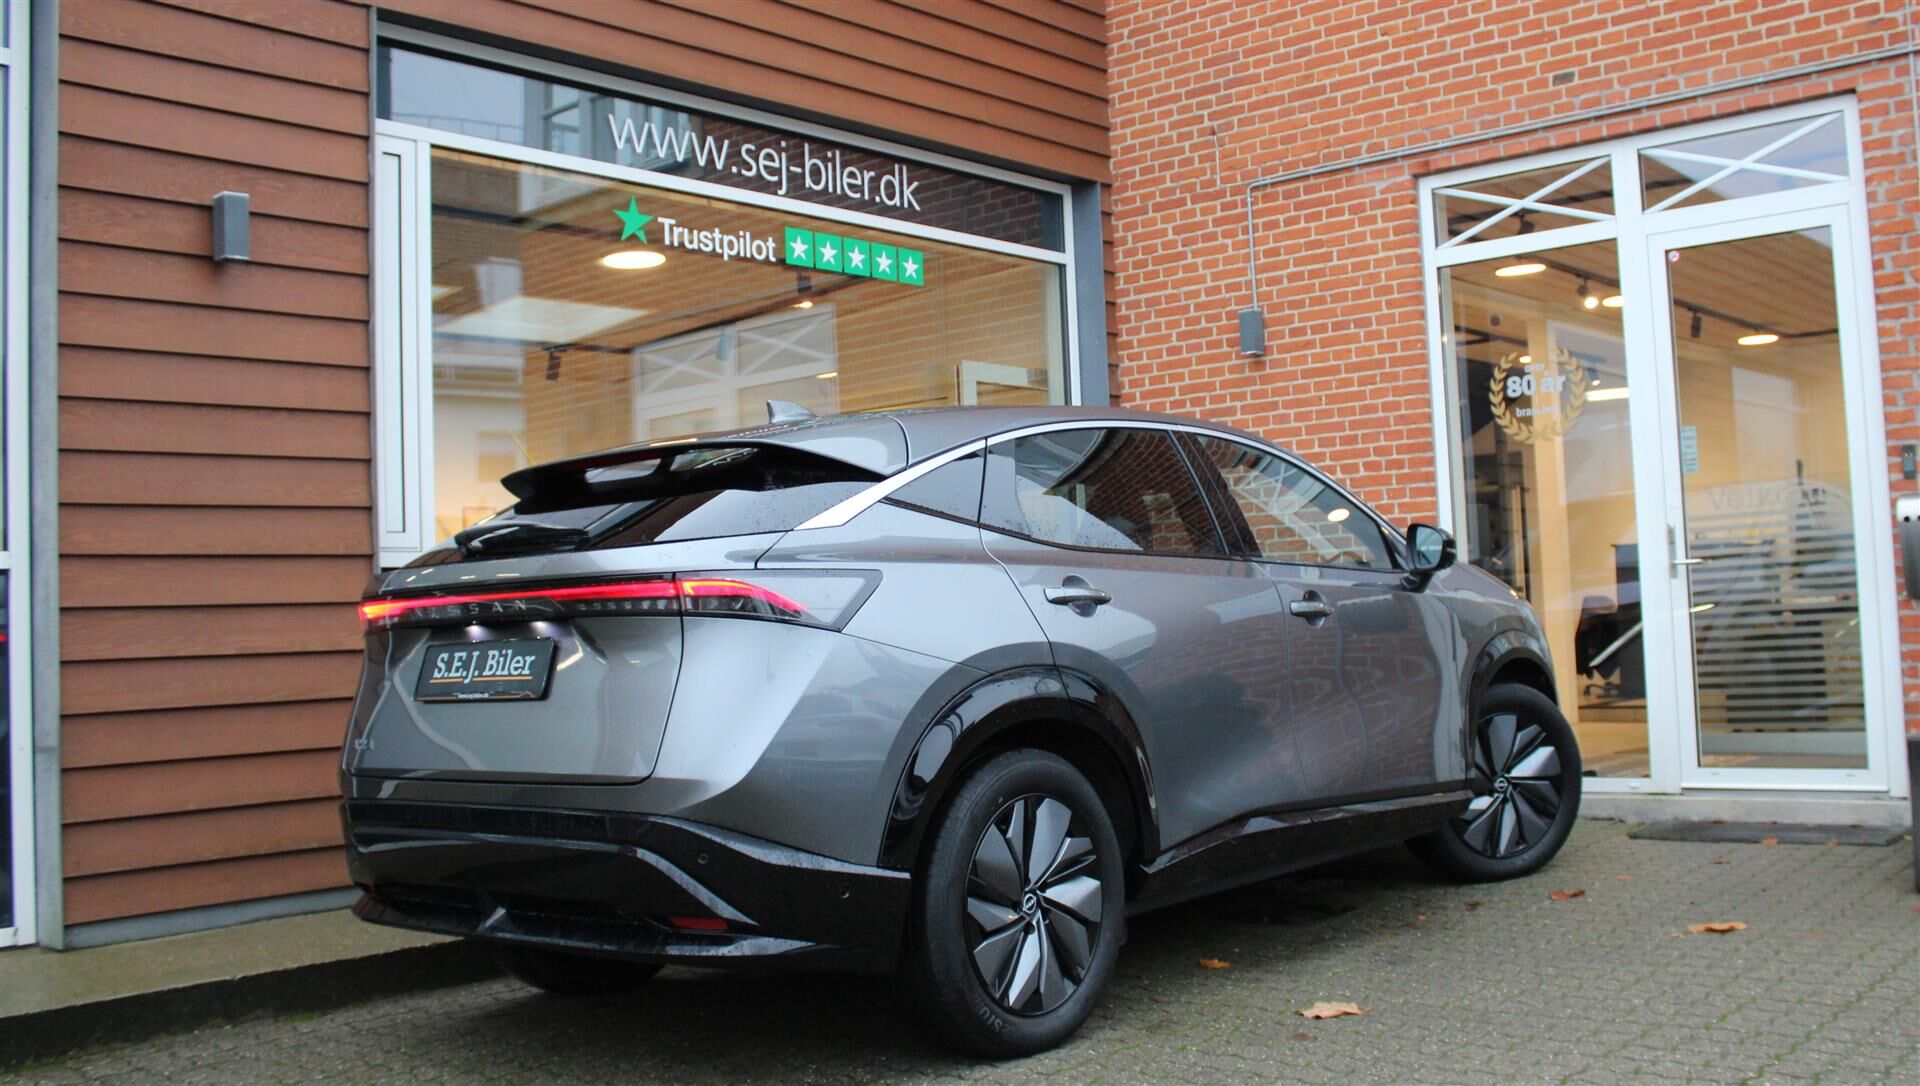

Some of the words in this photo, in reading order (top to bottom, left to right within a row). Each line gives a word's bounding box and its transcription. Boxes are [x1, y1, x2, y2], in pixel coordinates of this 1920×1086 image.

[608, 112, 921, 212] www.sej-biler.dk
[657, 216, 777, 262] Trustpilot
[1507, 375, 1536, 398] 80
[1540, 370, 1566, 393] år
[433, 651, 480, 683] S.E.J.
[482, 649, 536, 676] Biler
